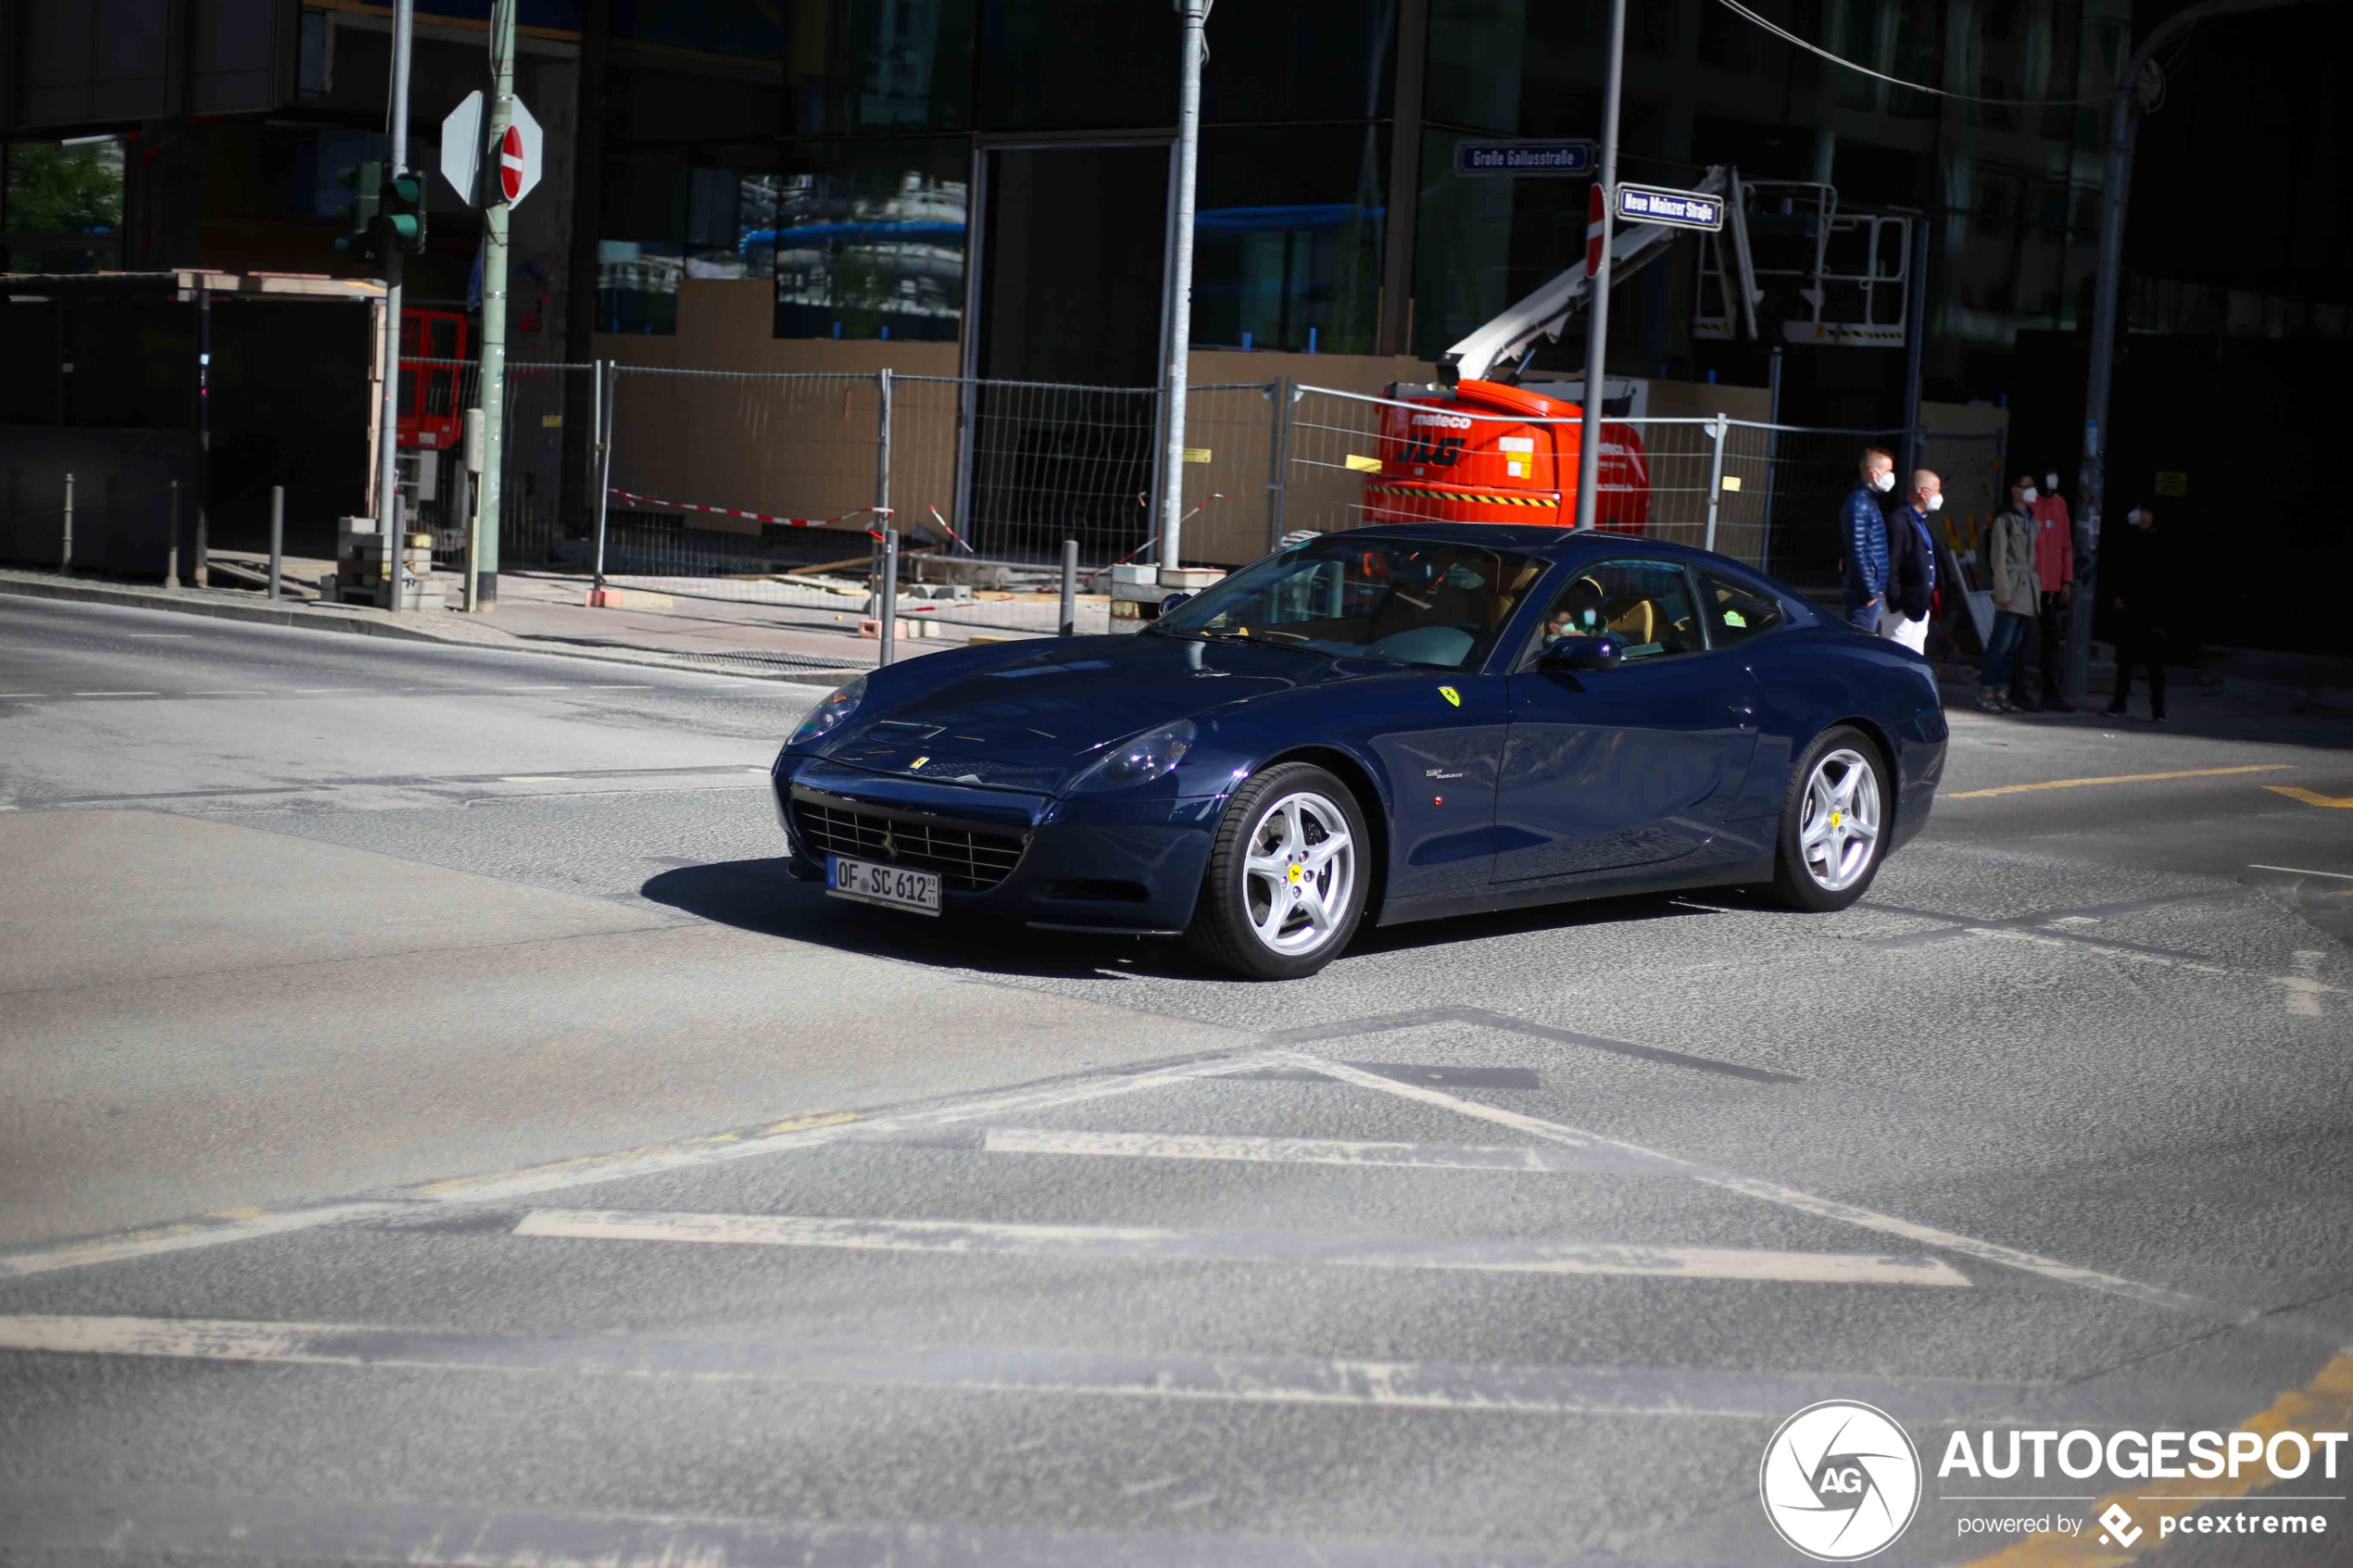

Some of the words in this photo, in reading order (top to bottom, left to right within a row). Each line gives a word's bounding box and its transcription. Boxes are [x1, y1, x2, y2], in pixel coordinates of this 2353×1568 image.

[1473, 150, 1504, 166] Große
[1507, 150, 1574, 166] Gallusstraße
[1624, 193, 1648, 211] Neue
[1649, 195, 1685, 217] Mainzer
[1685, 201, 1713, 221] Straße
[1412, 414, 1472, 430] mateco
[1397, 435, 1466, 466] JLG
[838, 861, 859, 888] OF
[871, 867, 891, 896] SC
[896, 872, 926, 903] 612
